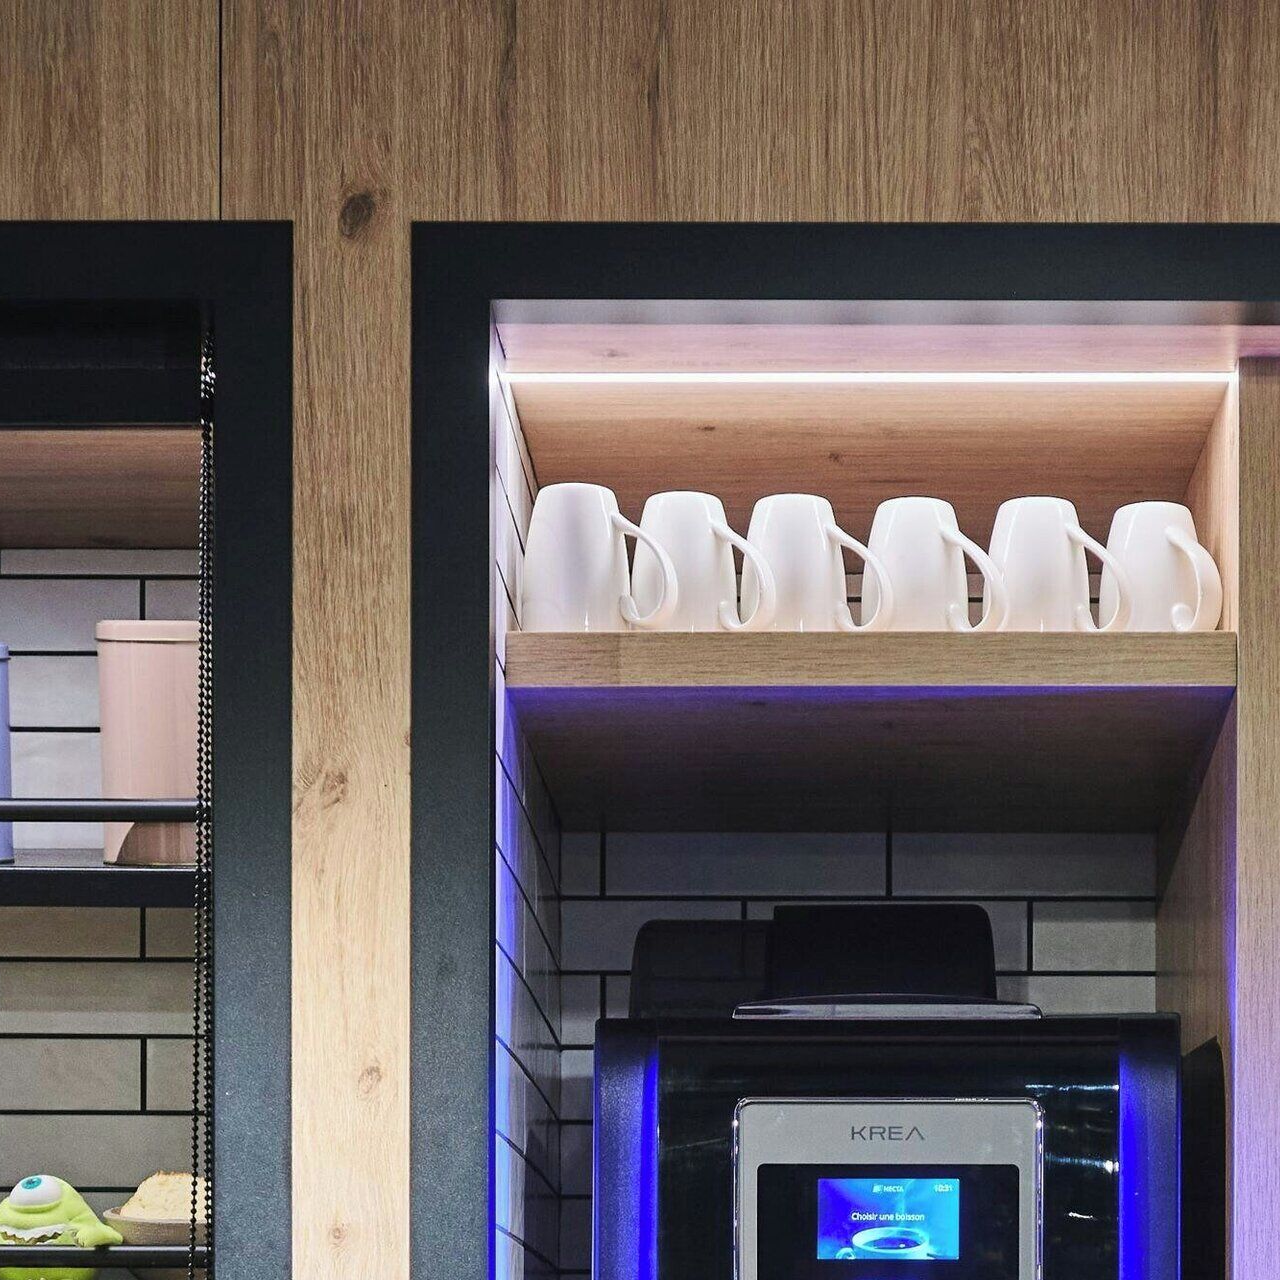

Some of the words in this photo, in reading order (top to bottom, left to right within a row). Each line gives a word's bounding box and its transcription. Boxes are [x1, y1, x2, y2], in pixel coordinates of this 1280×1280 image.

[851, 1126, 925, 1140] KREA
[851, 1212, 878, 1221] Choisir
[879, 1213, 894, 1221] une
[895, 1212, 925, 1221] boisson
